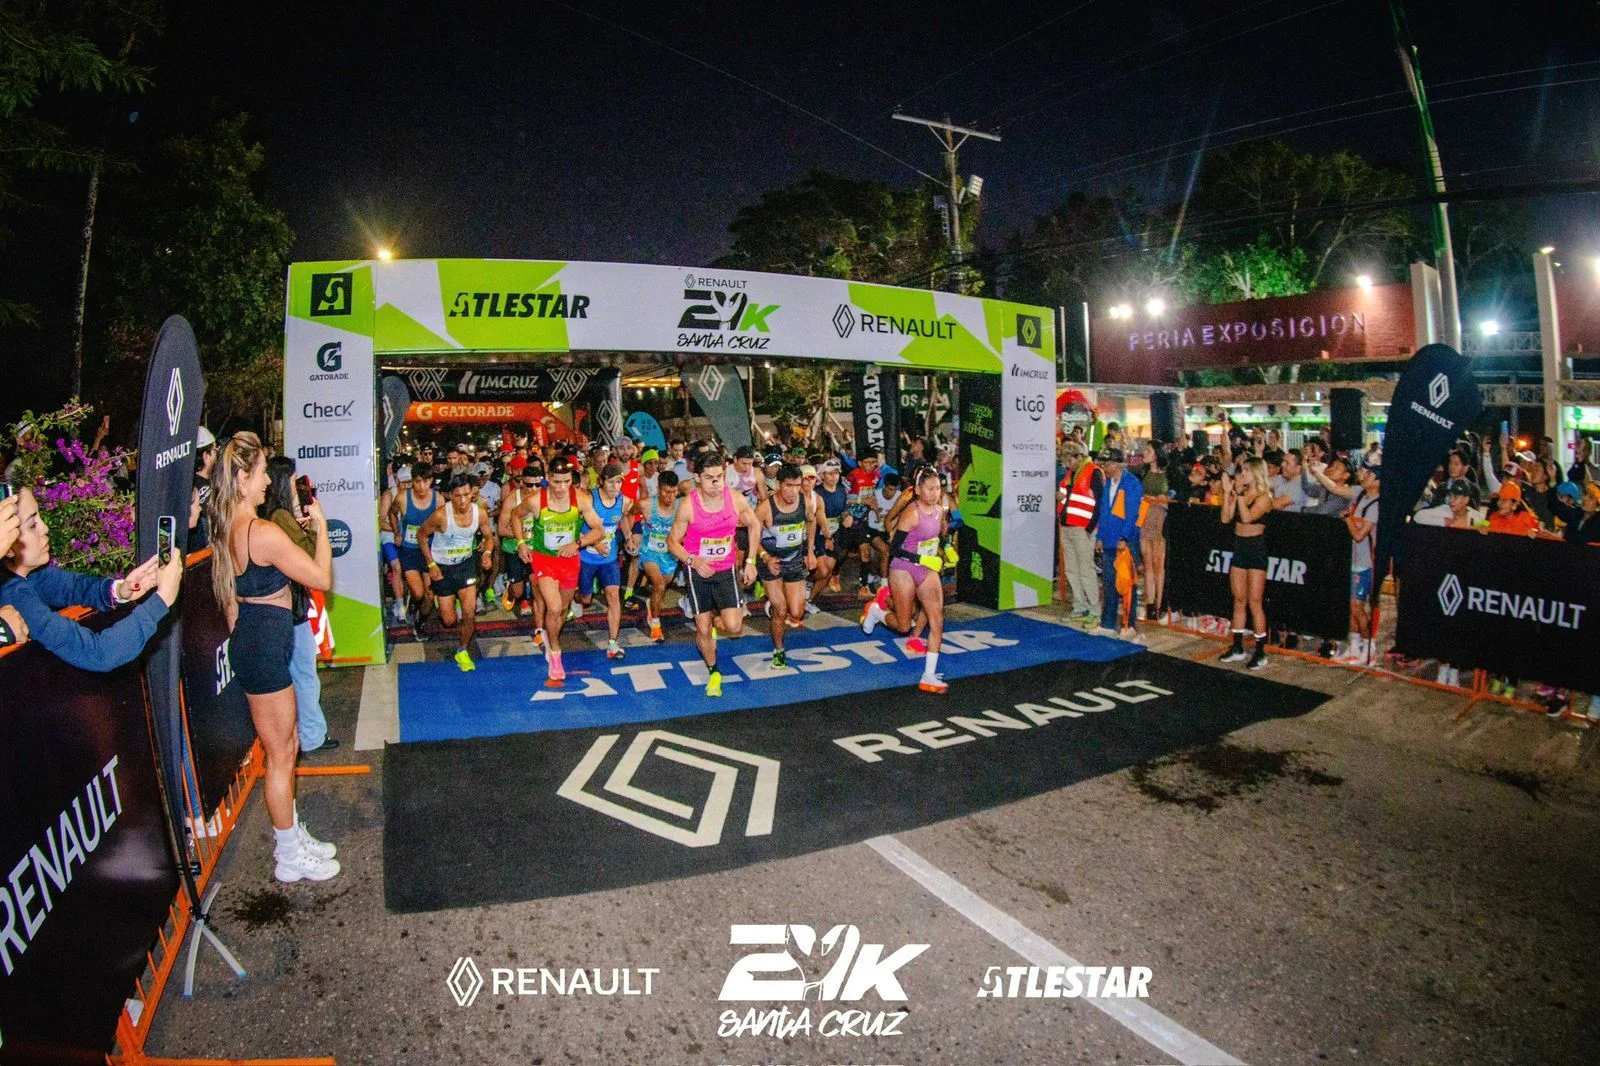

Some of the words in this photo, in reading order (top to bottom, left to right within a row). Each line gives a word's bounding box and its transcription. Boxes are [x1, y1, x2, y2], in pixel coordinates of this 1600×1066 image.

[698, 277, 748, 289] RENAULT
[448, 292, 591, 319] ATLESTAR
[860, 313, 957, 340] RENAULT
[727, 335, 771, 350] CRUZ
[1128, 327, 1196, 352] FERIA
[309, 373, 349, 382] GATORADE
[480, 375, 540, 389] IMCRUZ
[438, 405, 514, 417] GATORADE
[1410, 401, 1455, 430] RENAULT
[1012, 443, 1048, 451] NOVOTEL
[155, 440, 192, 470] RENAULT
[1020, 470, 1049, 478] TRUPER
[1020, 503, 1041, 513] CRUZ
[555, 535, 565, 544] 7
[706, 547, 726, 556] 10
[1467, 586, 1587, 630] RENAULT
[832, 679, 1175, 763] RENAULT
[0, 754, 122, 977] RENAULT
